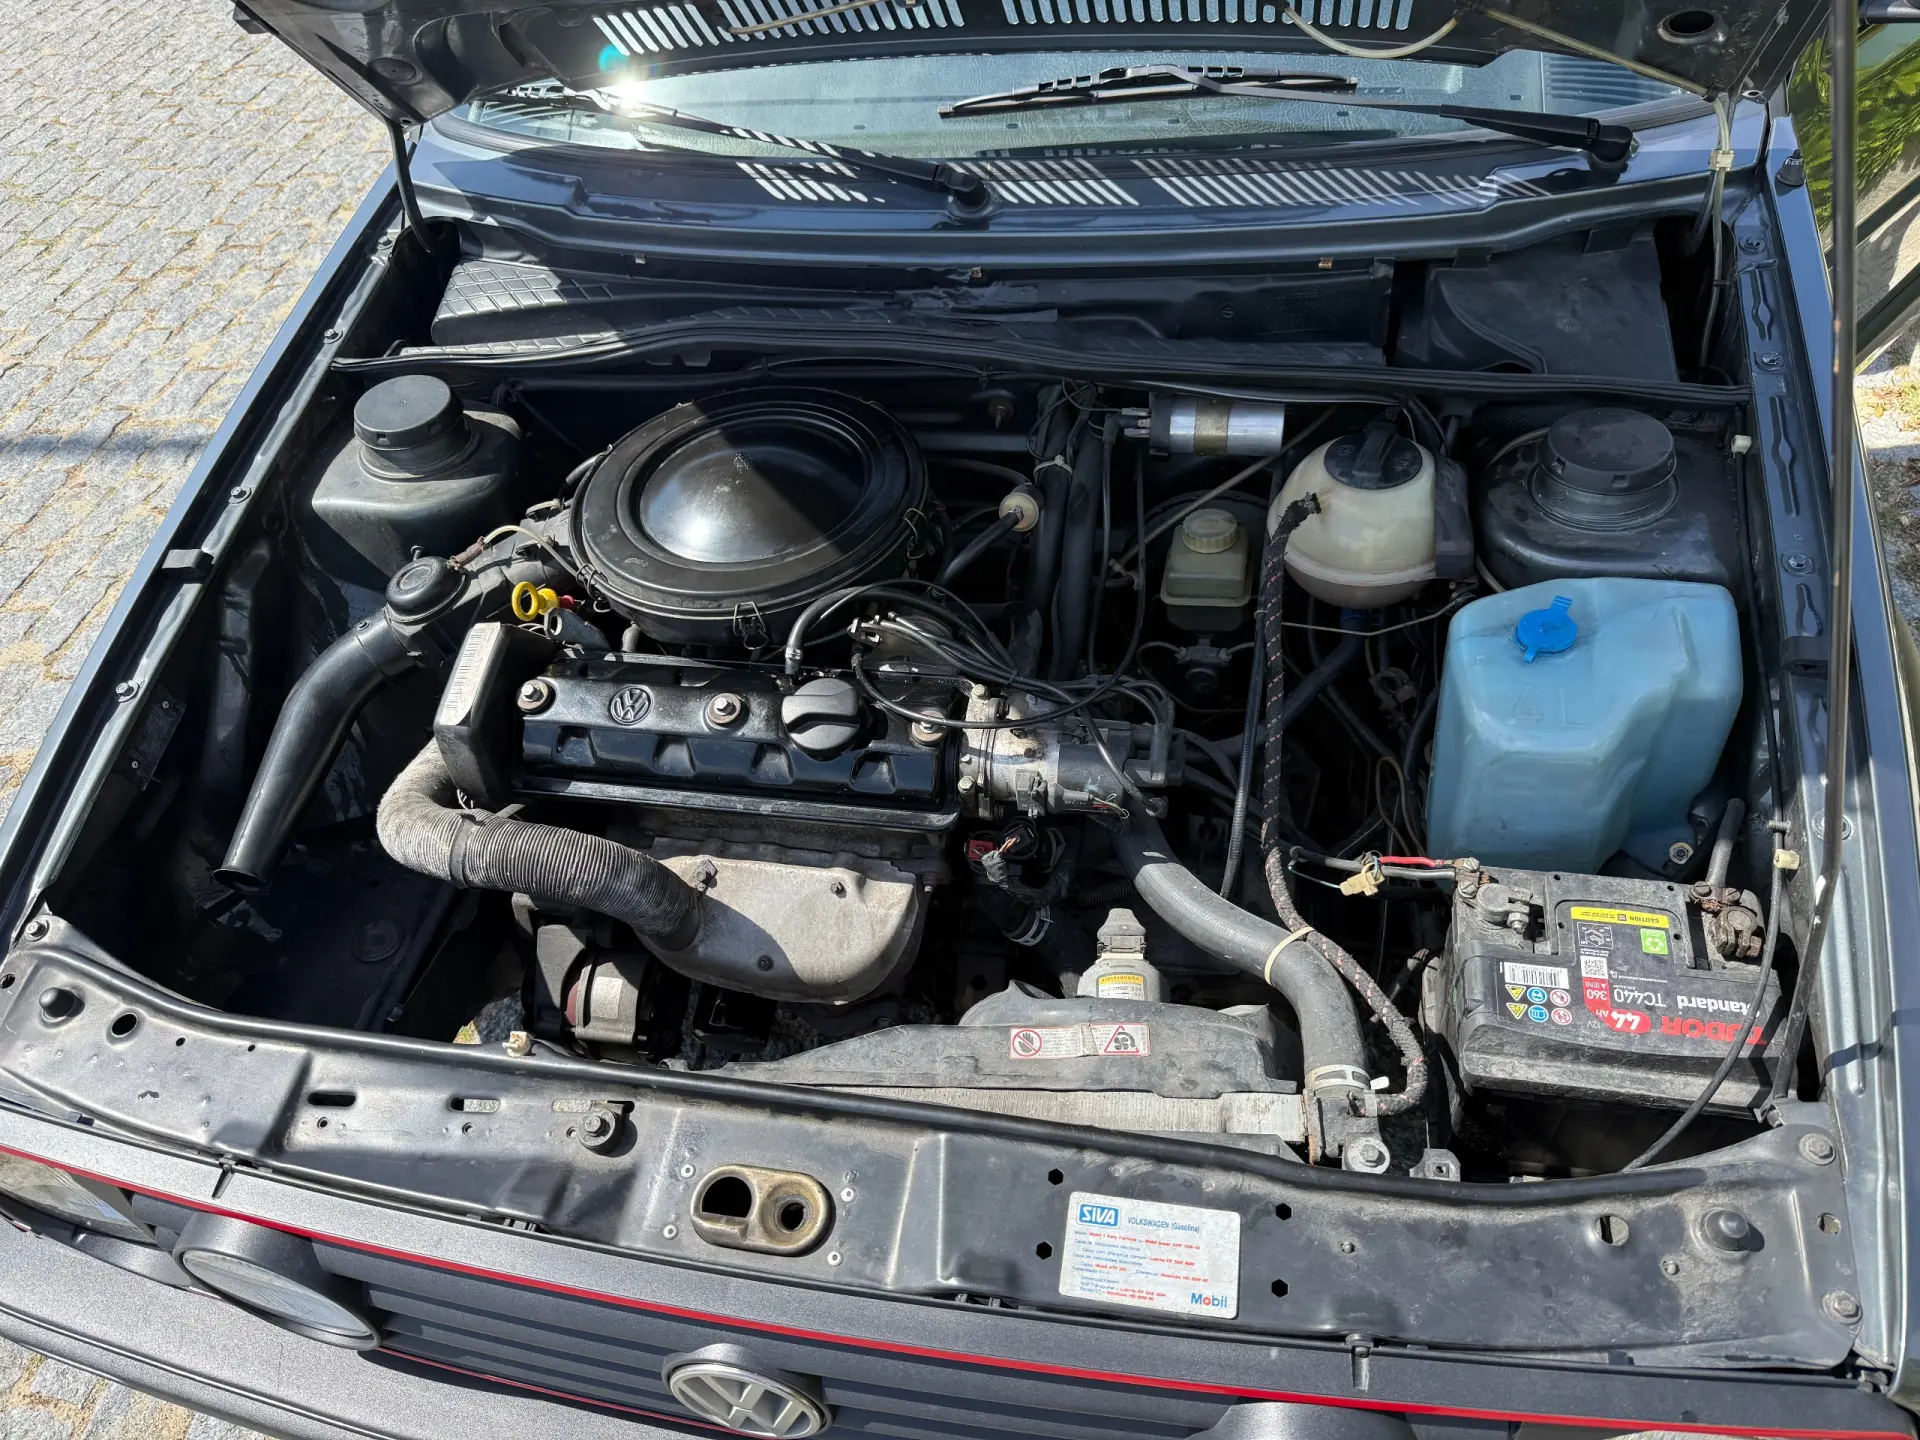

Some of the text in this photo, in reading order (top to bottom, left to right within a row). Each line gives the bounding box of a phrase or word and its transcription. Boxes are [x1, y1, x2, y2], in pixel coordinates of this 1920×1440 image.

[1629, 915, 1660, 924] CAUTION
[1586, 989, 1608, 1001] 360
[1613, 988, 1667, 1008] TC440
[1586, 1020, 1601, 1029] 12V
[1595, 1009, 1640, 1031] 44 Ah
[1081, 1205, 1116, 1227] SIVA
[1127, 1216, 1200, 1233] VOLKSWAGEN (Gasolina)
[1190, 1292, 1228, 1308] Mobil
